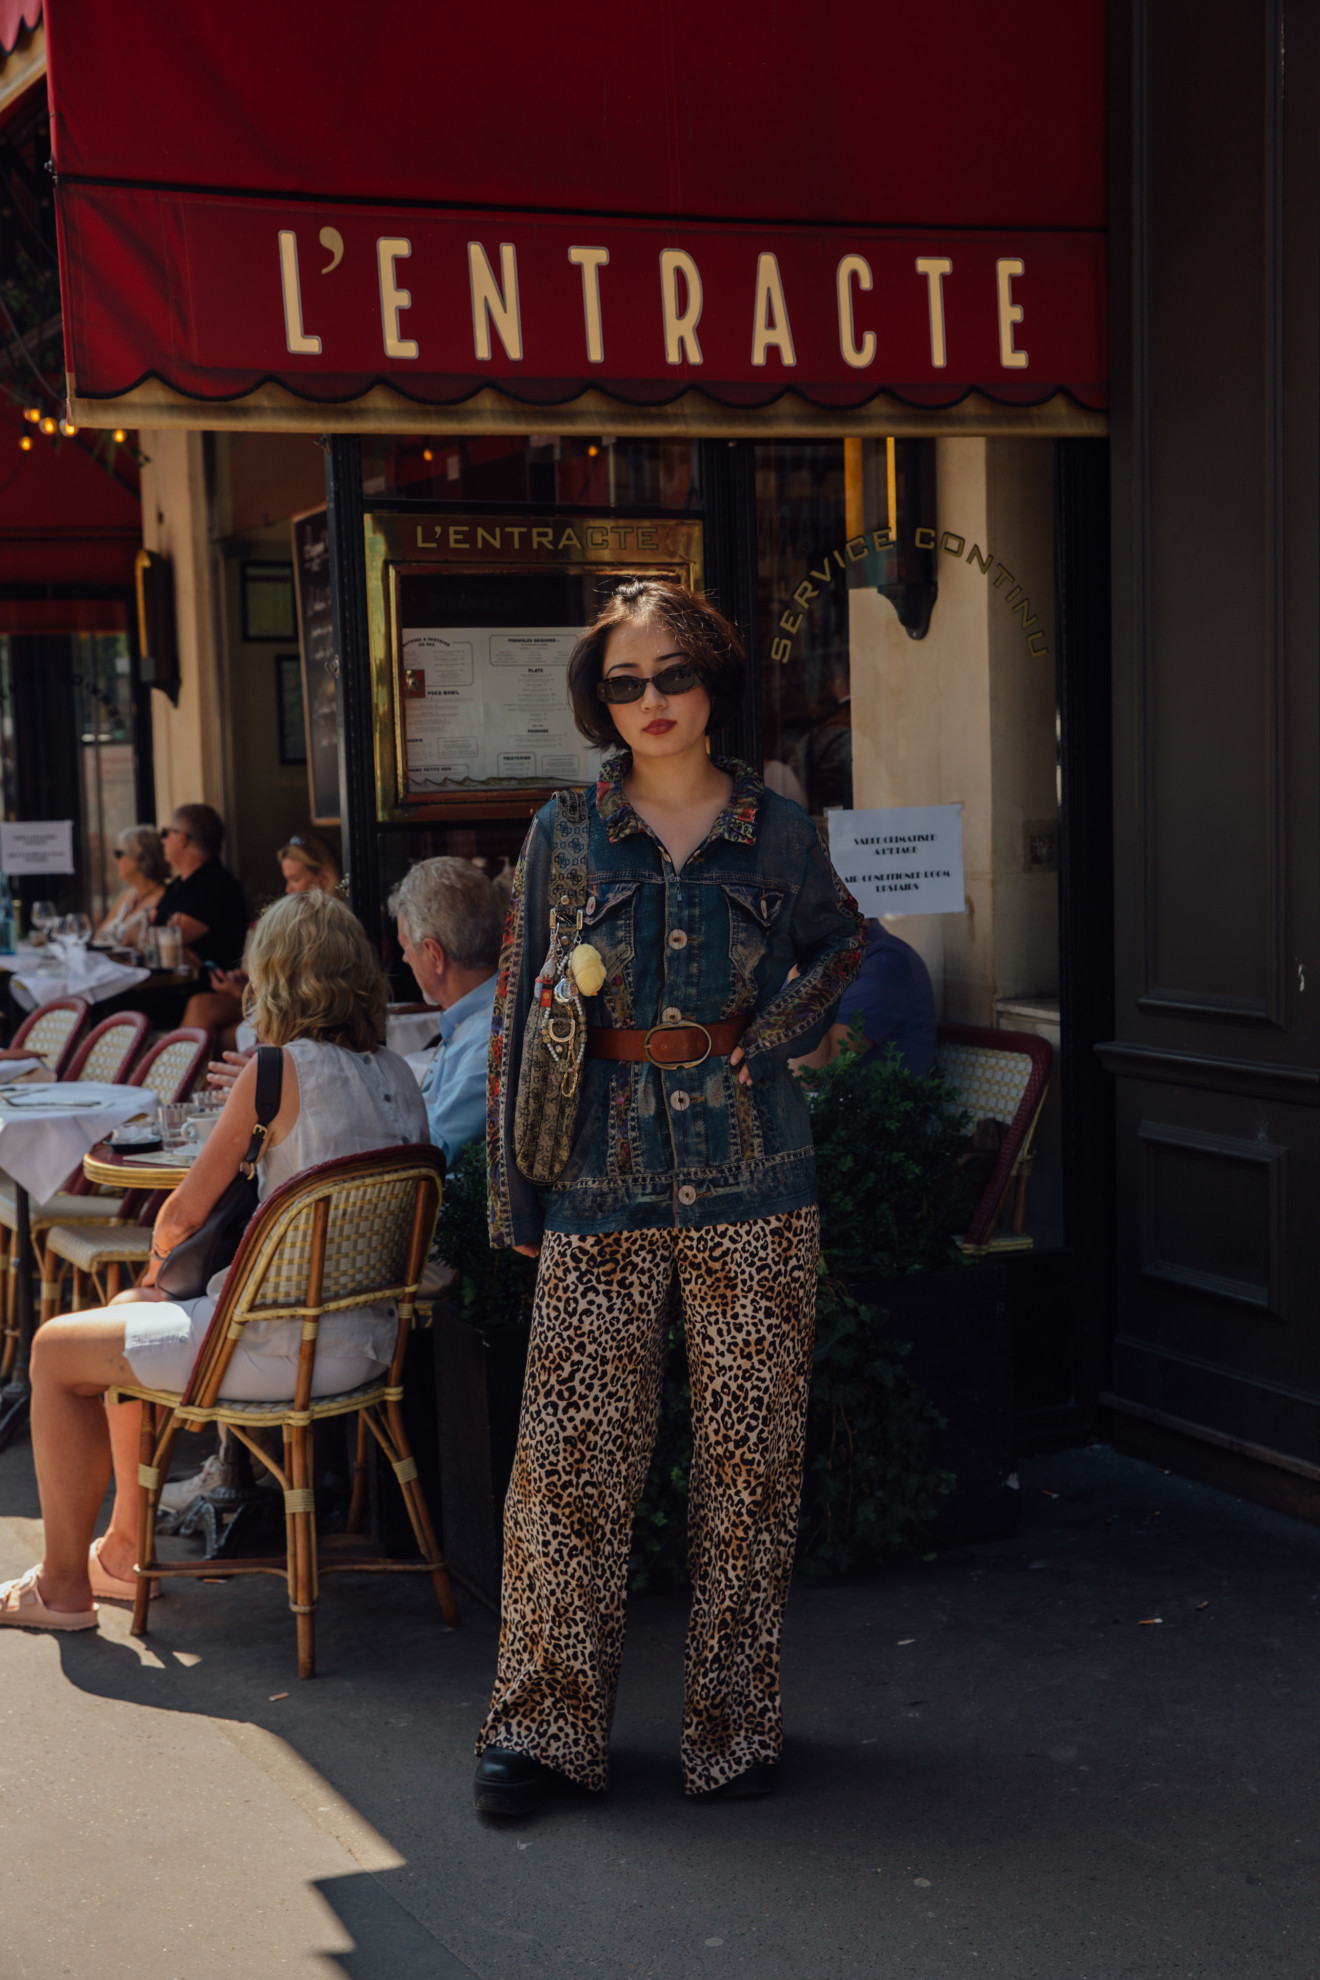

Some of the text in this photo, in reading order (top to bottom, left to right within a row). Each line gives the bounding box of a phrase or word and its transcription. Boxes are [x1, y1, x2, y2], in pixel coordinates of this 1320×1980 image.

[278, 225, 1030, 370] L'ENTRACTE
[416, 525, 659, 550] L'ENTRACTE
[770, 527, 896, 664] SERVICE
[914, 527, 1049, 659] CONTINU
[844, 869, 951, 884] AIR CONDITIONED ROOM
[876, 884, 919, 893] UPSTAIRS
